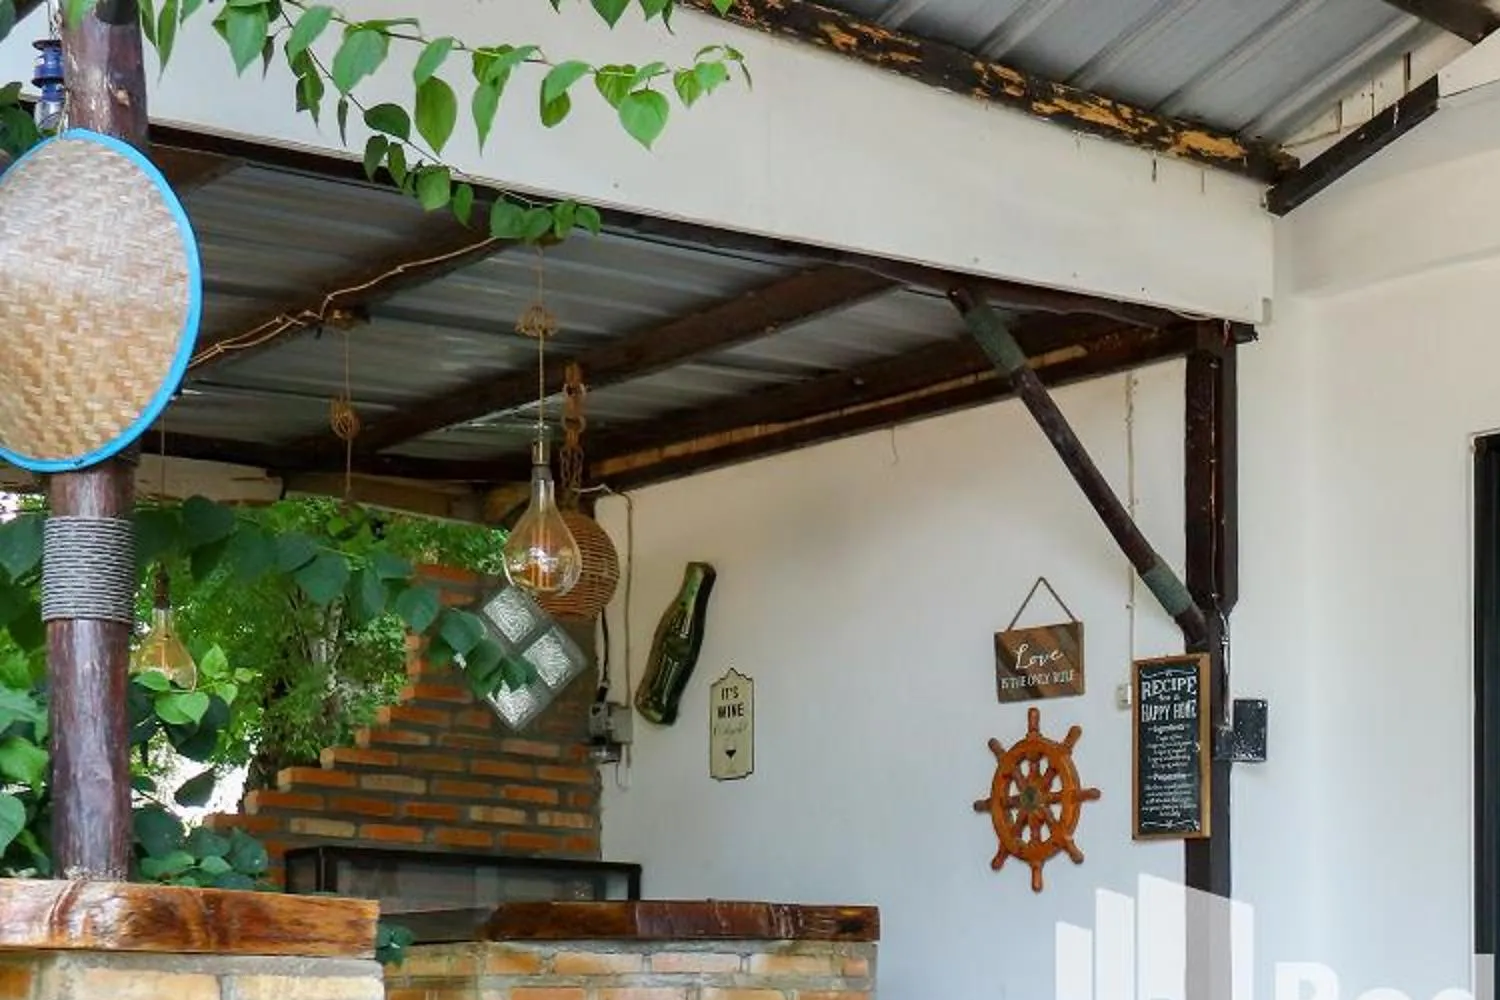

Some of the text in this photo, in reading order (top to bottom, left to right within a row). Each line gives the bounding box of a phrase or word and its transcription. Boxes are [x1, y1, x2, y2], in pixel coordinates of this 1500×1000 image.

[1011, 643, 1065, 670] Love
[721, 685, 740, 701] IT'S
[1141, 675, 1198, 701] RECIPE
[1141, 703, 1171, 723] HAPPY
